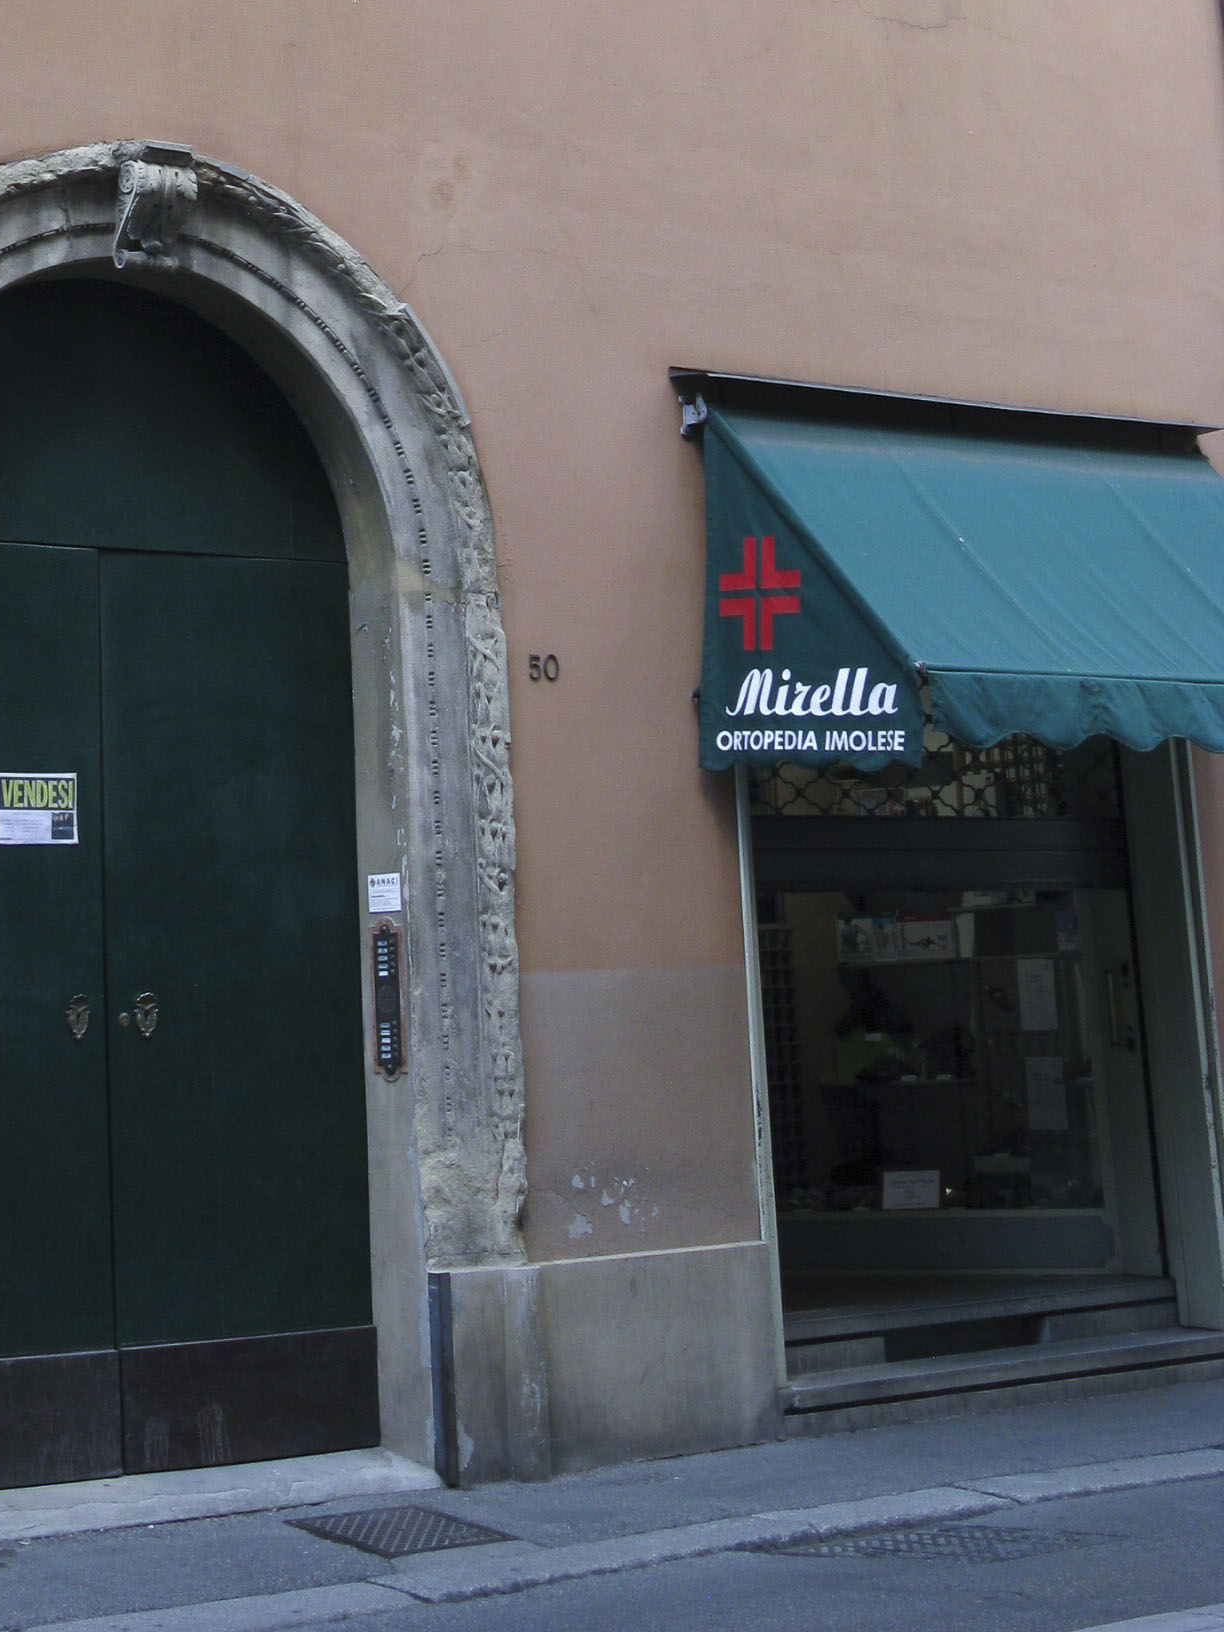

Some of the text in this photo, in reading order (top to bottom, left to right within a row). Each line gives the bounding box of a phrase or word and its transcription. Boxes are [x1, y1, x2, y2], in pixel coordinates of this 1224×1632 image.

[528, 653, 559, 683] 50
[726, 667, 898, 716] Mirella
[716, 730, 905, 751] ORTOPEDIA IMOLESE
[1, 779, 73, 808] VENDESI
